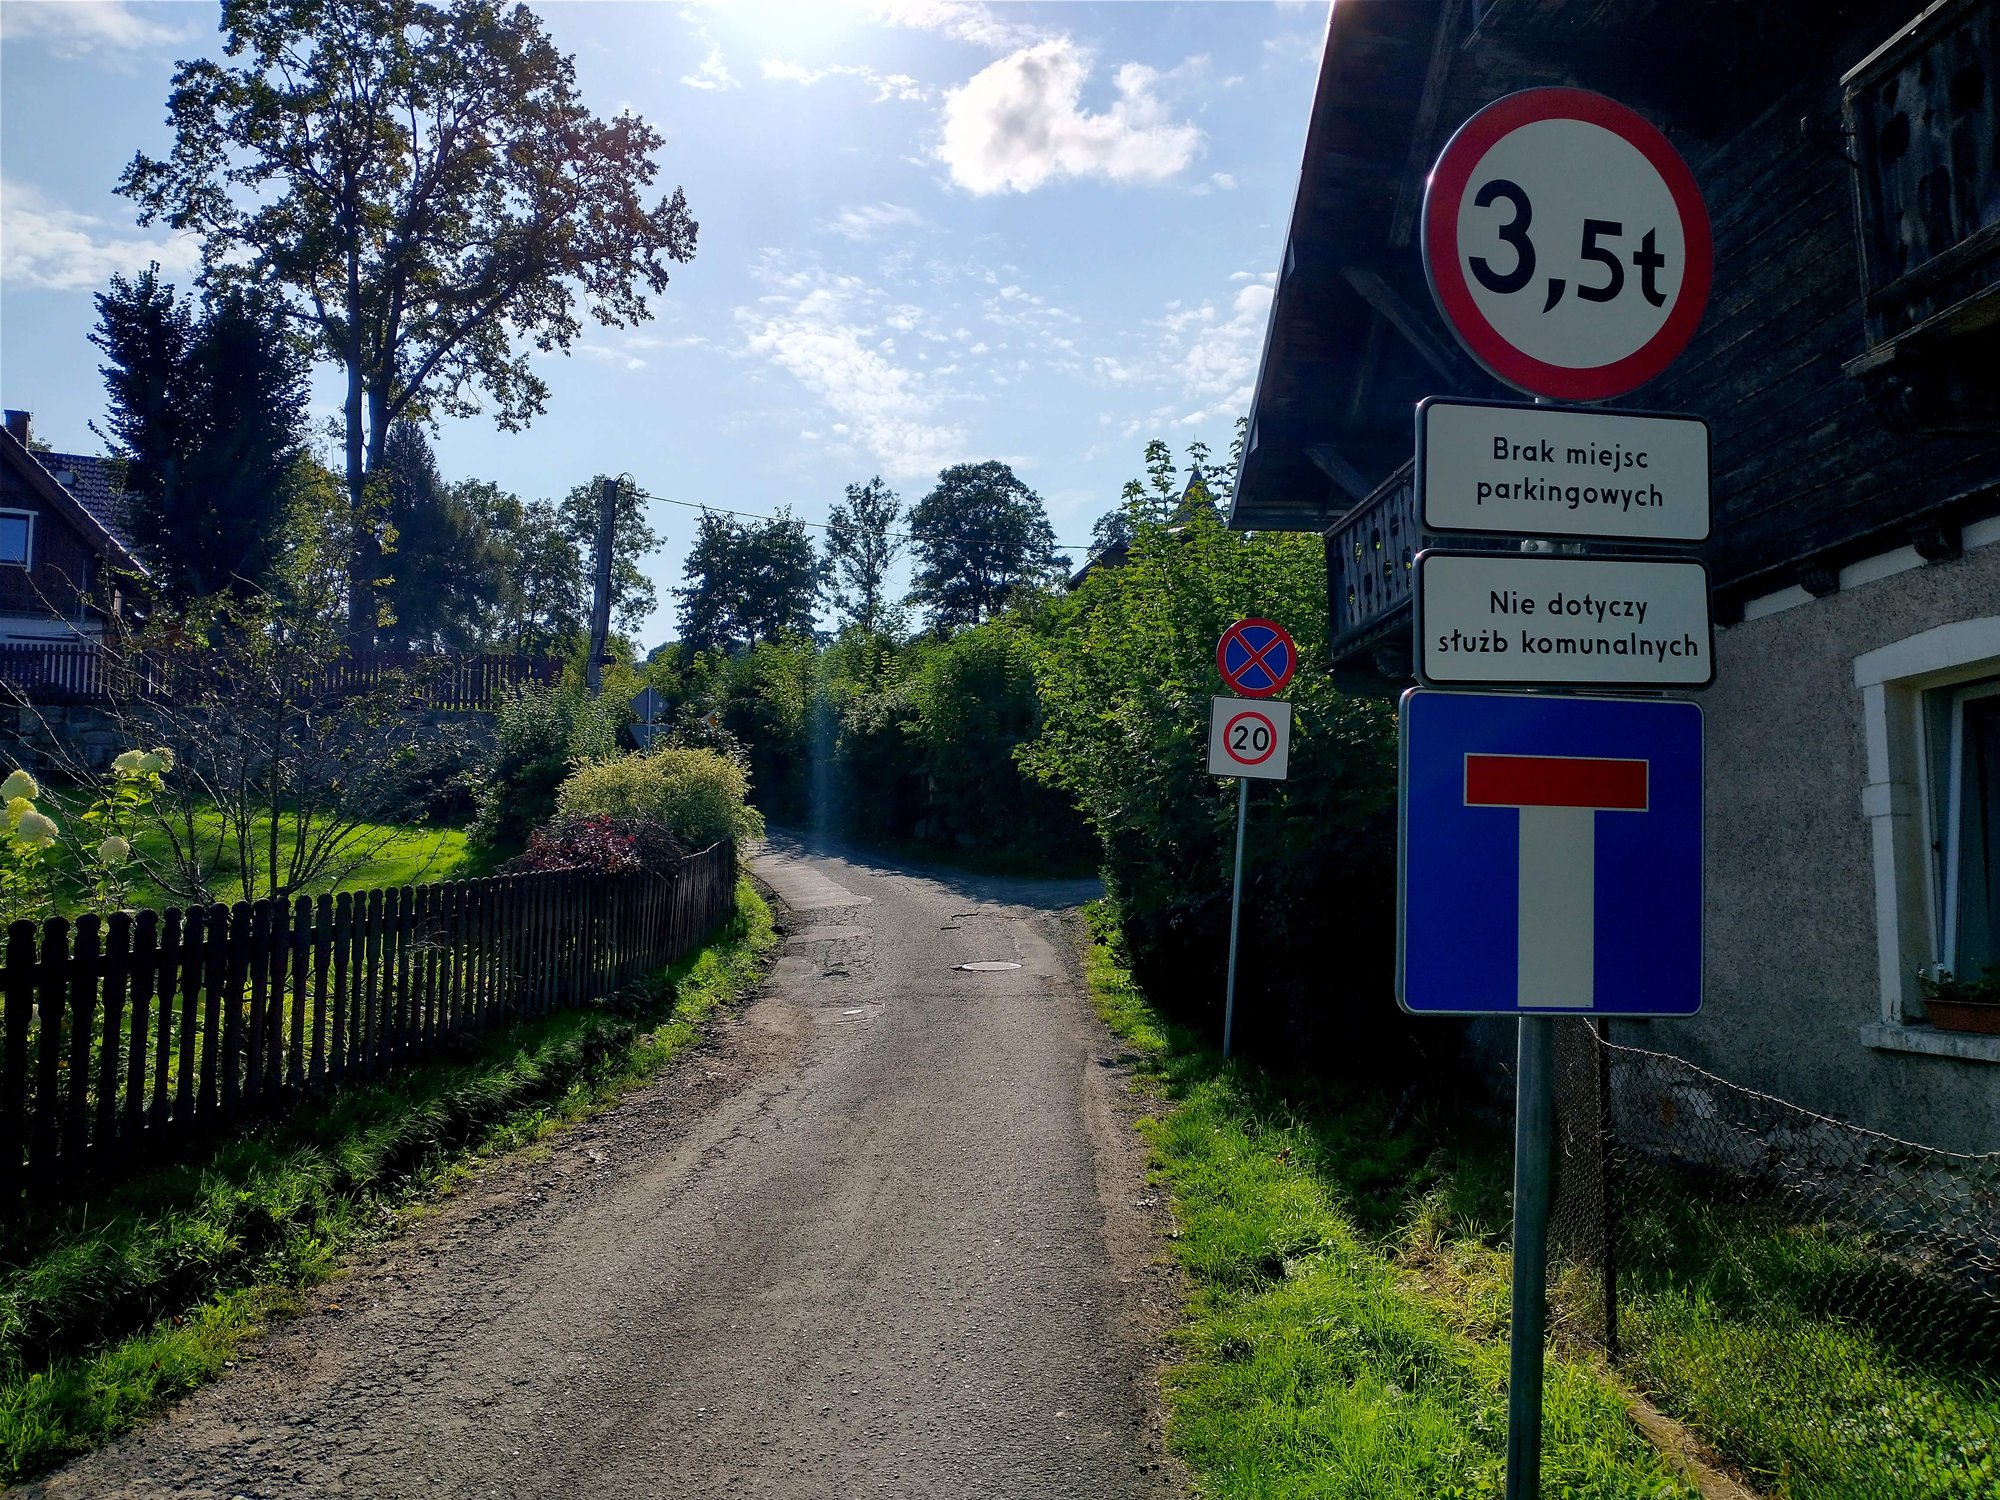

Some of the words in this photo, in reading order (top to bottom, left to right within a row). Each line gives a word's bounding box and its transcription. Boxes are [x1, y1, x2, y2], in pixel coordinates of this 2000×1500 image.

[1468, 178, 1667, 314] 3,5t
[1493, 436, 1555, 463] Brak
[1566, 442, 1649, 473] miejsc
[1476, 477, 1664, 512] parkingowych
[1489, 590, 1536, 615] Nie
[1547, 592, 1648, 624] dotyczy
[1438, 628, 1509, 653] służb
[1521, 629, 1699, 662] komunalnych
[1232, 725, 1270, 752] 20
